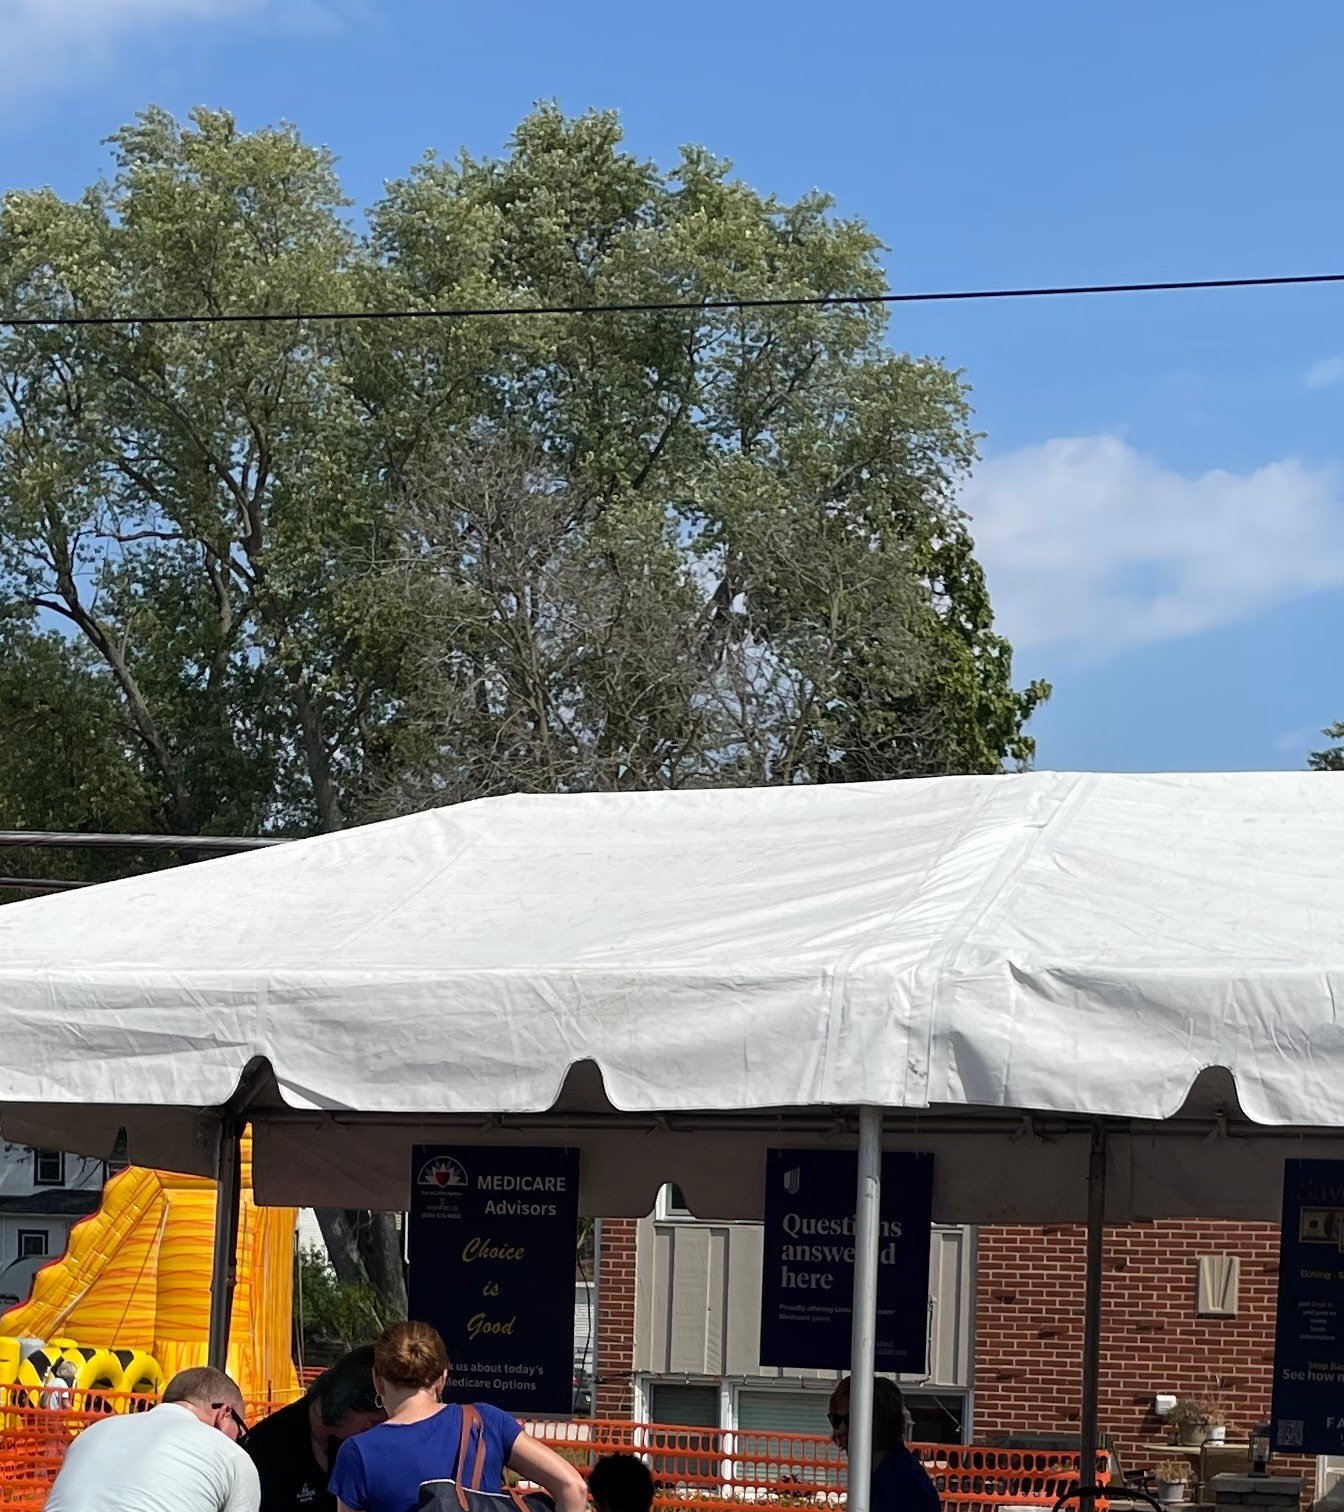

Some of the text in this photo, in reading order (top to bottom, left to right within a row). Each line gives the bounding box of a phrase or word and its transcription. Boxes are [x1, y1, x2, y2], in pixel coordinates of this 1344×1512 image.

[477, 1175, 566, 1191] MEDICARE
[484, 1200, 557, 1216] Advisors
[782, 1213, 902, 1238] Questins
[461, 1237, 525, 1263] Choice
[781, 1243, 896, 1264] answed
[780, 1265, 834, 1289] here
[483, 1280, 500, 1296] is
[467, 1312, 517, 1340] Good
[456, 1364, 469, 1372] us
[471, 1362, 502, 1373] about
[504, 1363, 544, 1376] today's
[1282, 1369, 1305, 1380] See
[1308, 1369, 1335, 1382] how
[493, 1378, 537, 1391] Options
